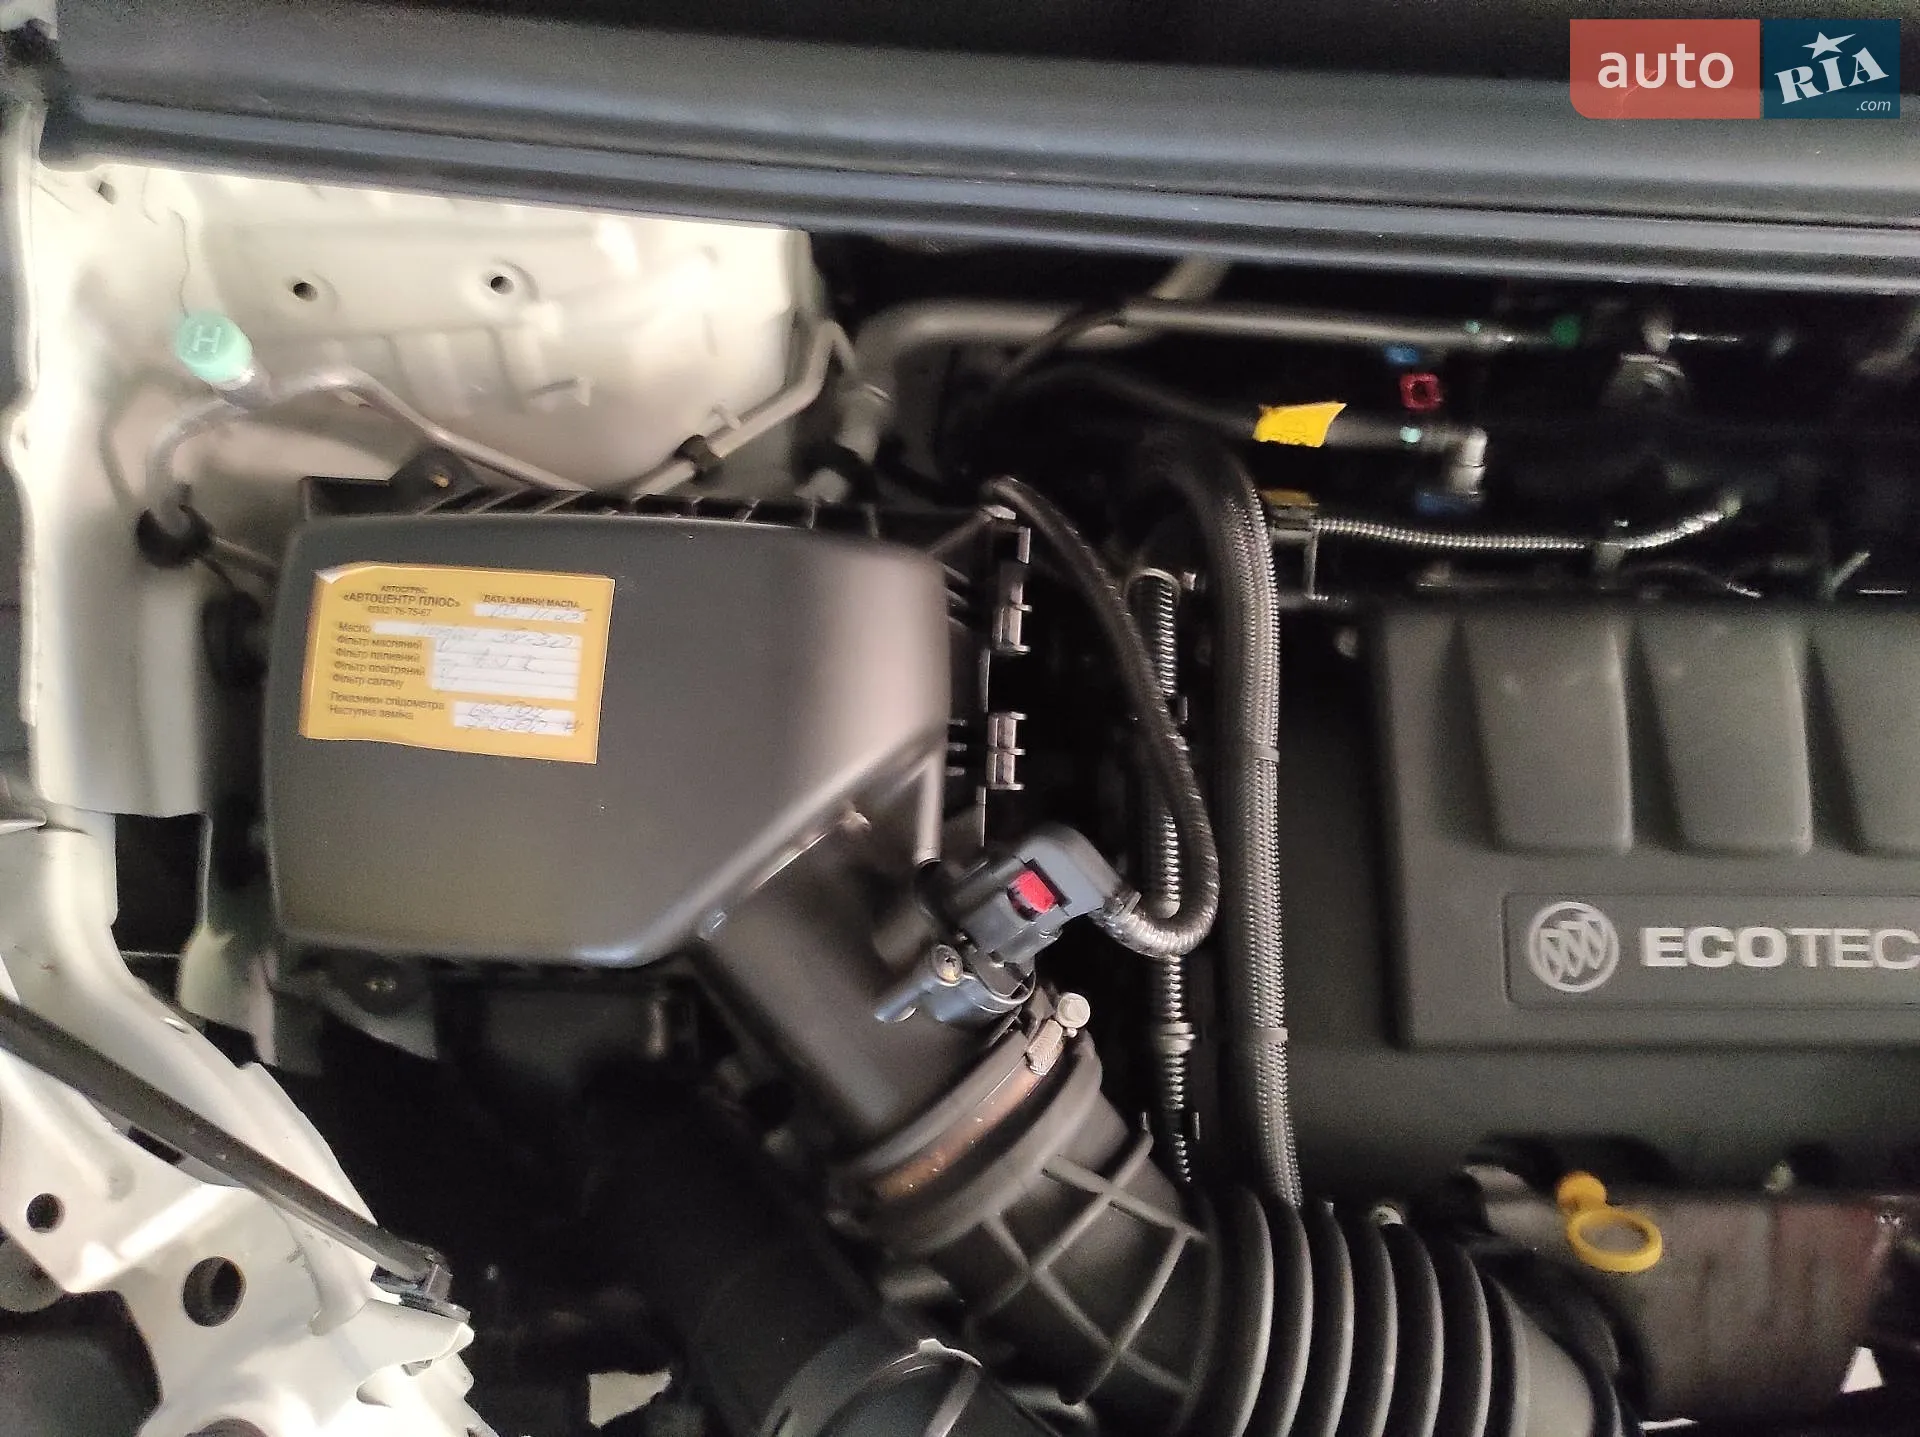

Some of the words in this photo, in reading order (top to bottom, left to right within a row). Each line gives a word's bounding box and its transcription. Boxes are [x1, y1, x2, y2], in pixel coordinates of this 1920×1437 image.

[191, 325, 221, 353] H
[343, 592, 417, 605] «АВТОЦЕНТР
[419, 595, 461, 608] ПЛЮС»
[483, 593, 507, 603] ДАТА
[509, 596, 545, 607] ЗАМІНИ
[546, 598, 580, 609] МАСЛА
[338, 621, 371, 633] Масло
[336, 635, 369, 647] Фільтр
[371, 639, 423, 650] масляний
[335, 647, 368, 659] Фільтр
[370, 651, 420, 662] паливний
[334, 660, 366, 672] Фільтр
[368, 663, 425, 676] повітряний
[332, 673, 365, 686] Фільтр
[367, 678, 405, 690] салону
[1639, 926, 1920, 970] ECOTEC
